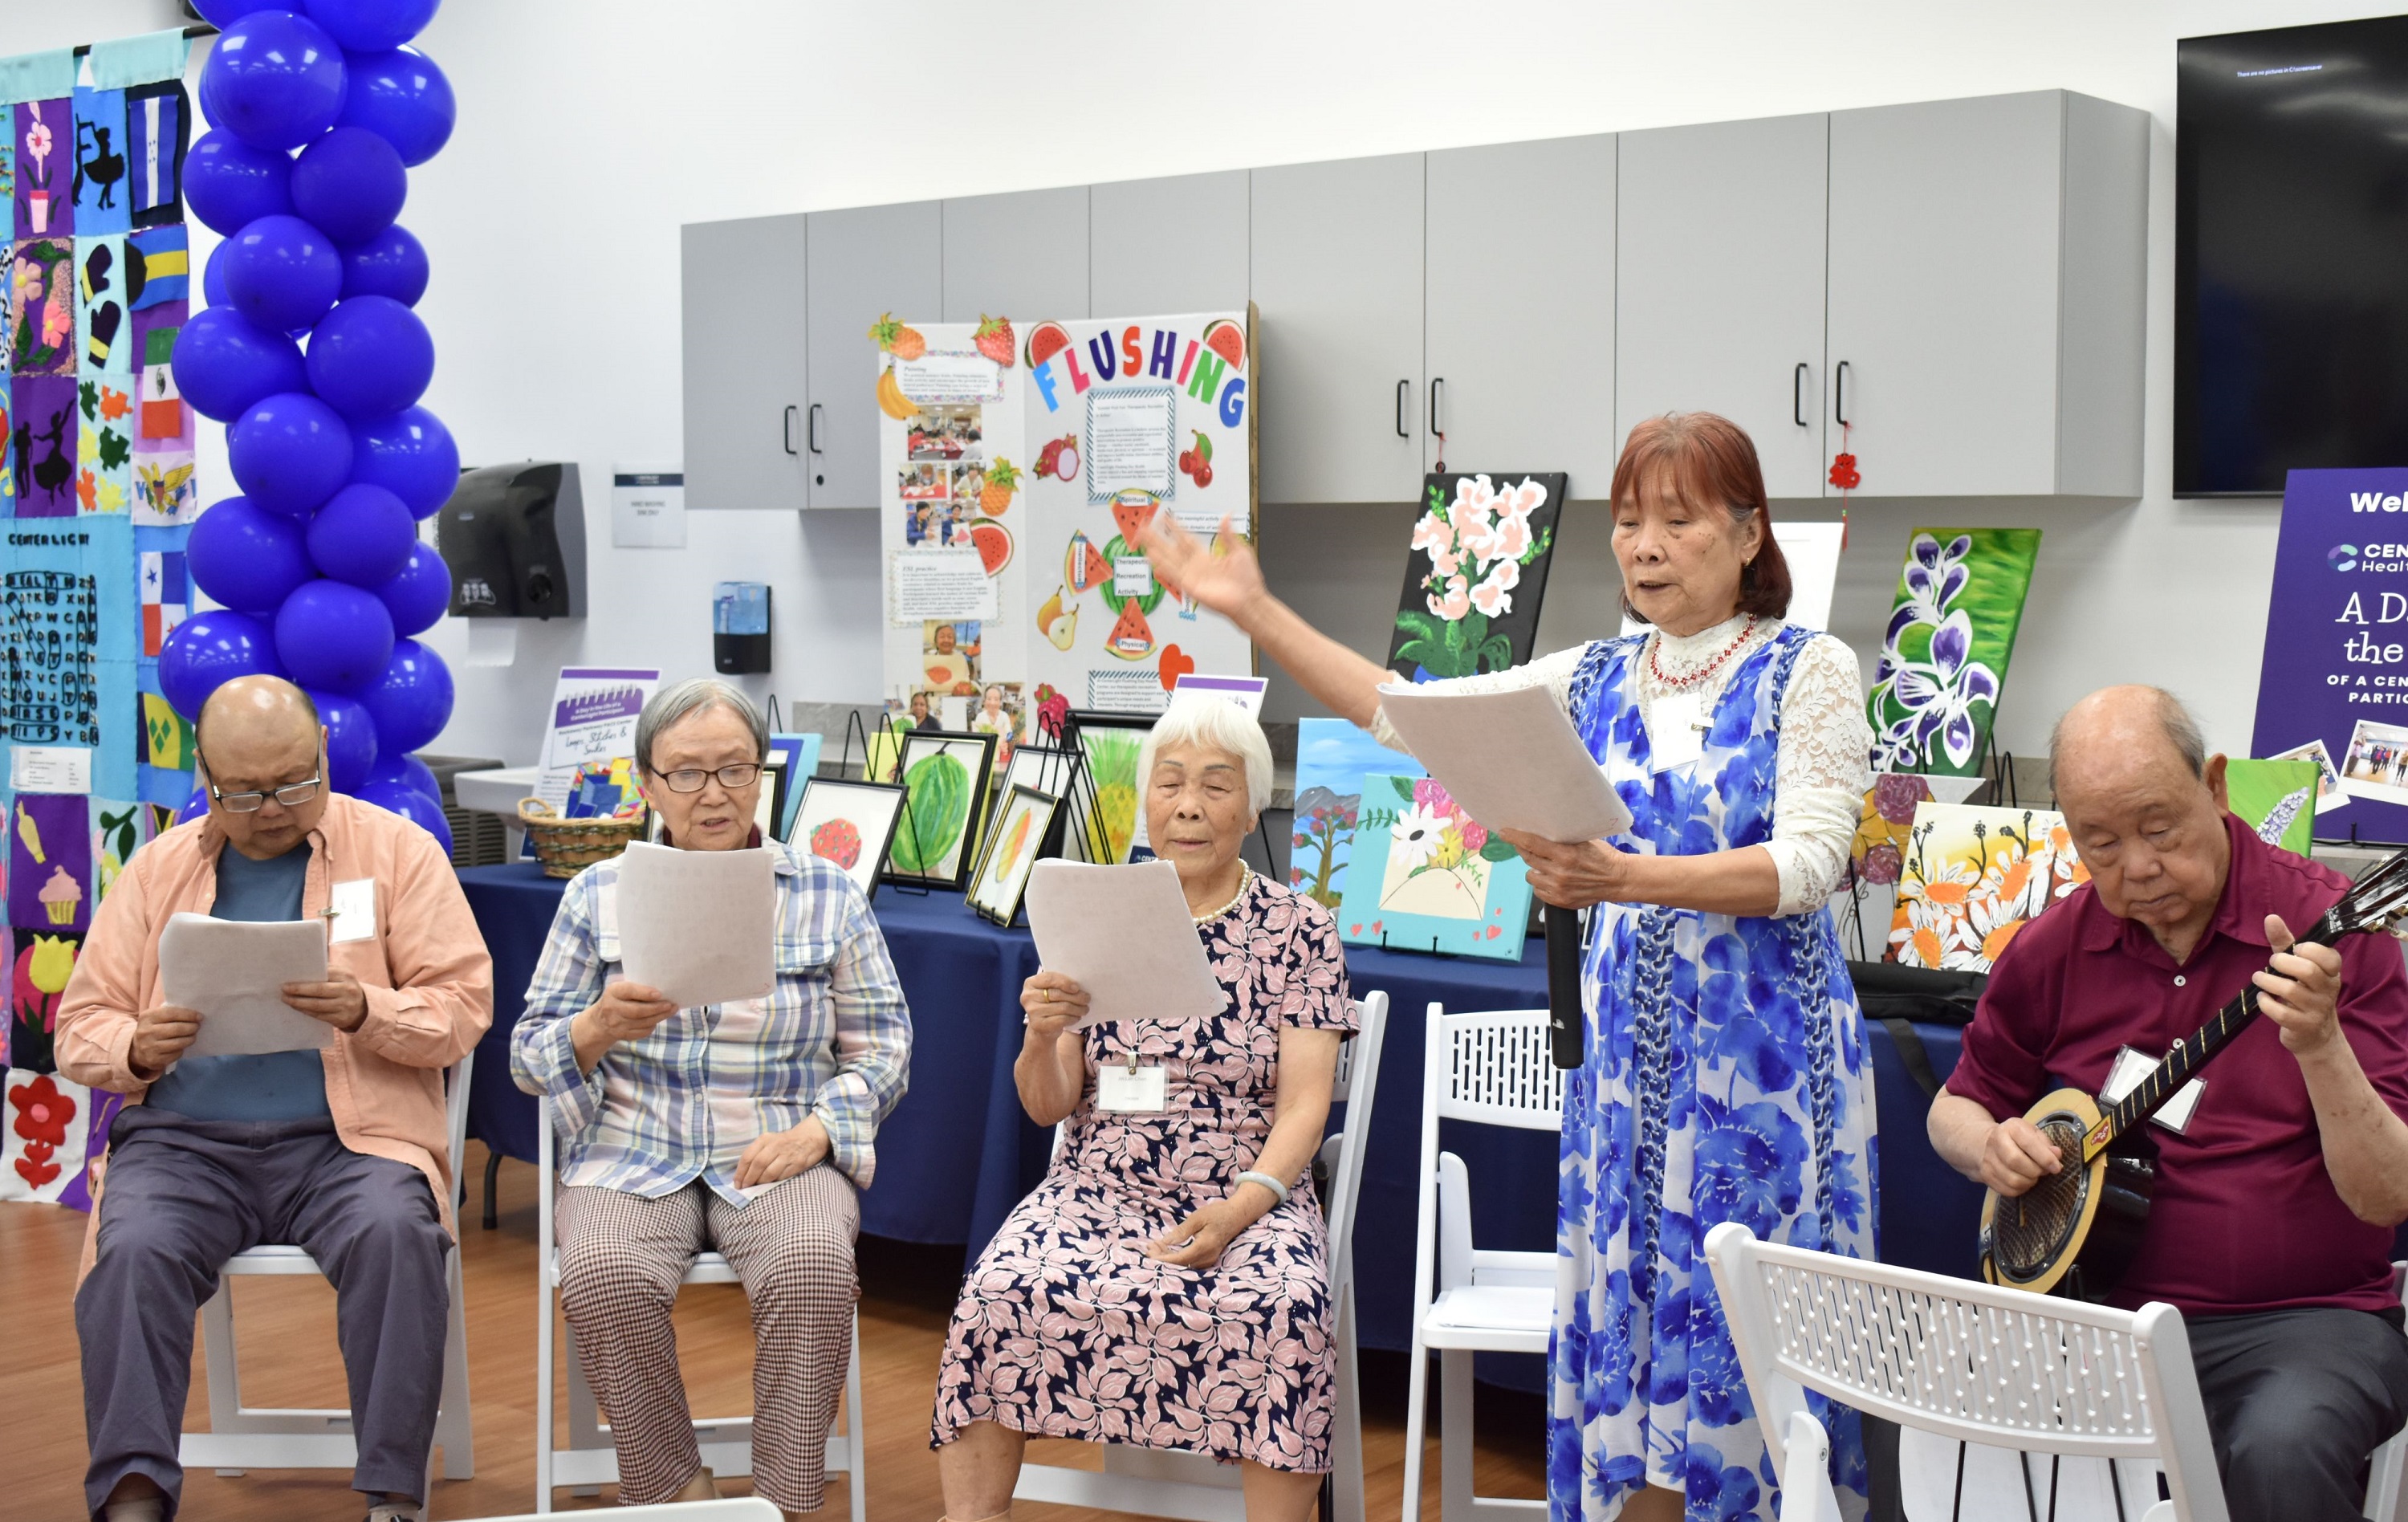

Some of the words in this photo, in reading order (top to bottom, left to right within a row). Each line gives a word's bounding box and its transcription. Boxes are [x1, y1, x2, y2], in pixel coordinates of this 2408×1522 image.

[1032, 325, 1246, 428] FLUSHING
[2335, 591, 2369, 625] A
[2377, 592, 2408, 623] D
[2343, 631, 2404, 665] the
[2327, 674, 2350, 686] OF
[2355, 675, 2368, 686] A
[2373, 676, 2408, 687] CEN
